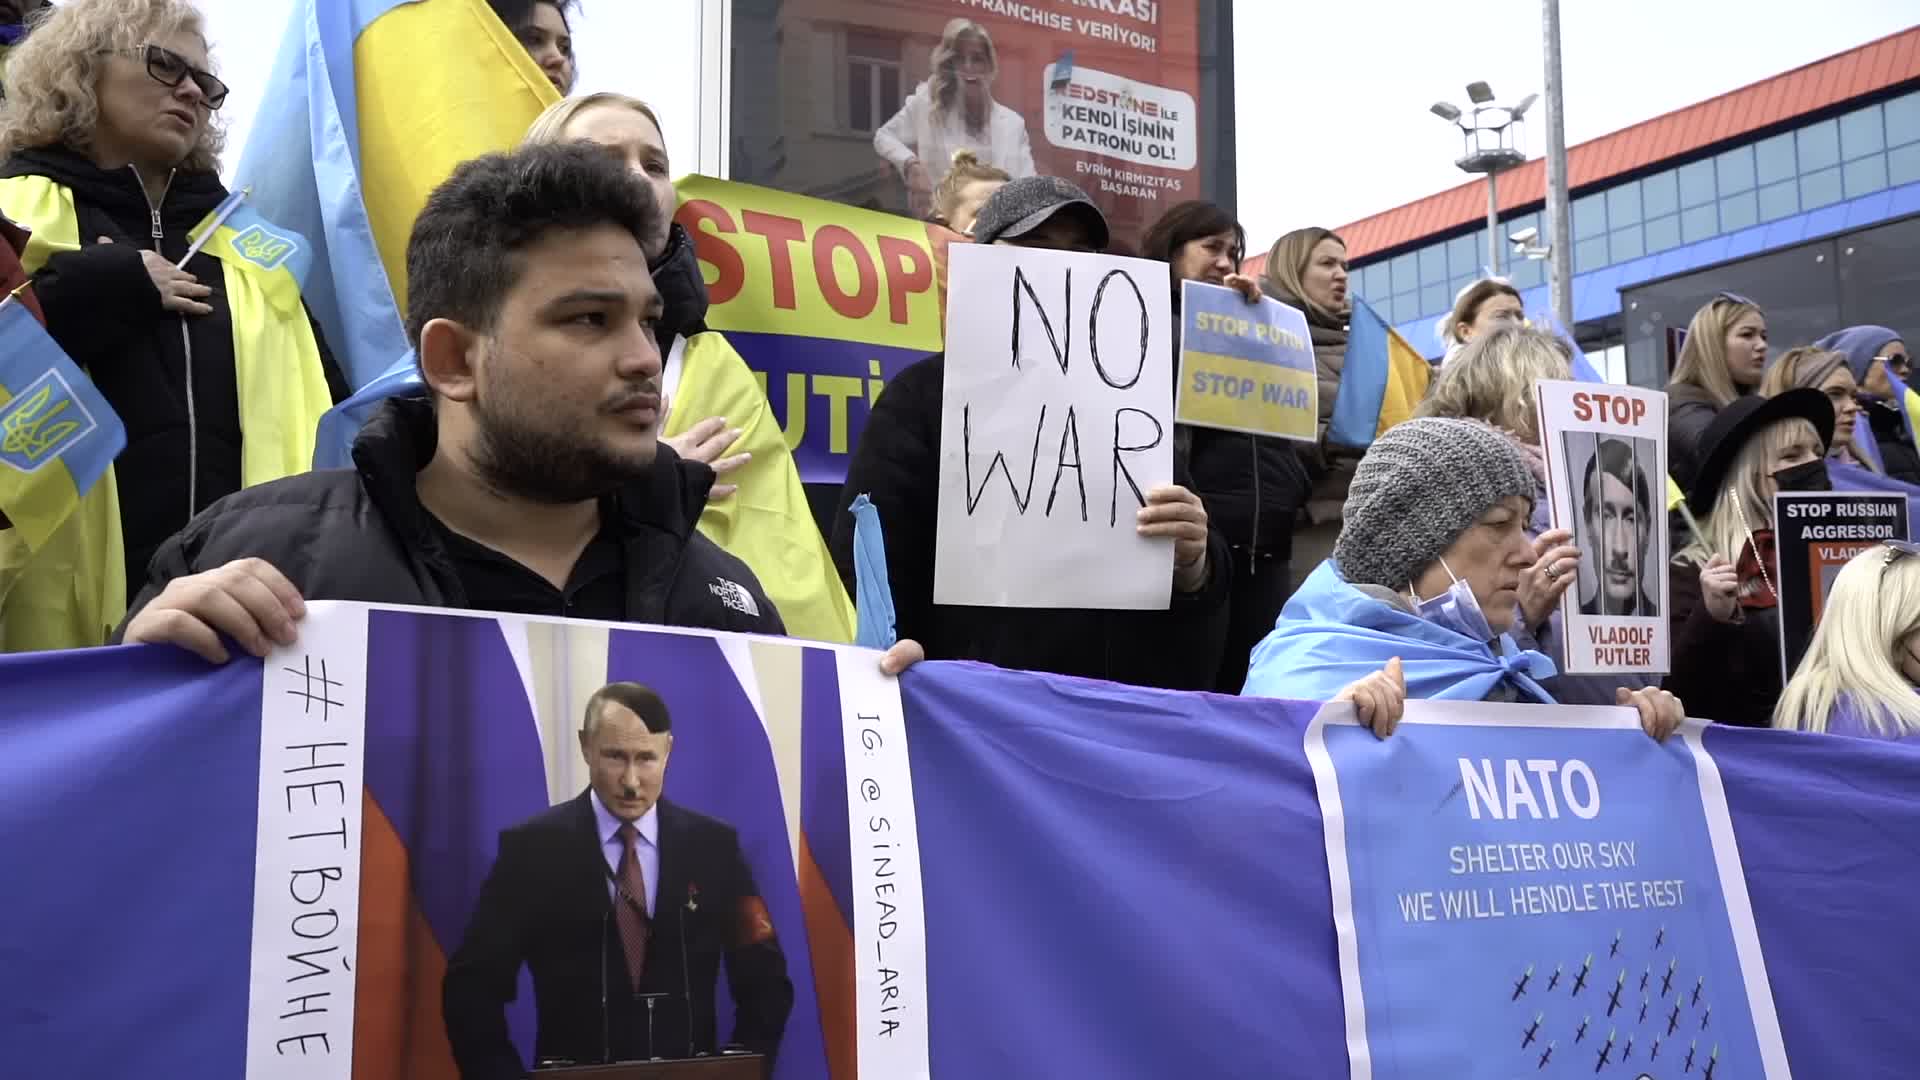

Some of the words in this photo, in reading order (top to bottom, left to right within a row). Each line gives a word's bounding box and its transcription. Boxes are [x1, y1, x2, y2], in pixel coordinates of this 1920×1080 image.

[1076, 19, 1156, 53] VERİYOR!
[1061, 103, 1117, 129] KENDİ
[1122, 113, 1175, 141] İŞİNİN
[1062, 125, 1142, 155] PATRONU
[1147, 144, 1176, 160] OL!
[1076, 160, 1112, 177] EVRİM
[1100, 180, 1157, 200] BAŞARAN
[674, 199, 933, 325] STOP
[1011, 265, 1149, 390] NO
[1196, 311, 1249, 337] STOP
[1192, 369, 1255, 400] STOP
[1262, 383, 1309, 410] WAR
[1573, 392, 1646, 427] STOP
[963, 402, 1164, 528] WAR
[1786, 503, 1832, 518] STOP
[1836, 503, 1897, 517] RUSSIAN
[1800, 525, 1894, 539] AGGRESSOR
[708, 583, 741, 601] NORTH
[716, 576, 737, 593] THE
[1588, 625, 1654, 646] VLADOLF
[1594, 647, 1650, 666] PUTLER
[1457, 758, 1600, 820] NATO
[1450, 843, 1549, 874] SHELTER
[1552, 842, 1596, 870] OUR
[1599, 840, 1638, 868] SKY
[1399, 891, 1436, 923] WE
[1440, 888, 1504, 920] WILL
[1510, 883, 1599, 916] HENDLE
[1599, 882, 1640, 909] THE
[1642, 880, 1684, 907] REST
